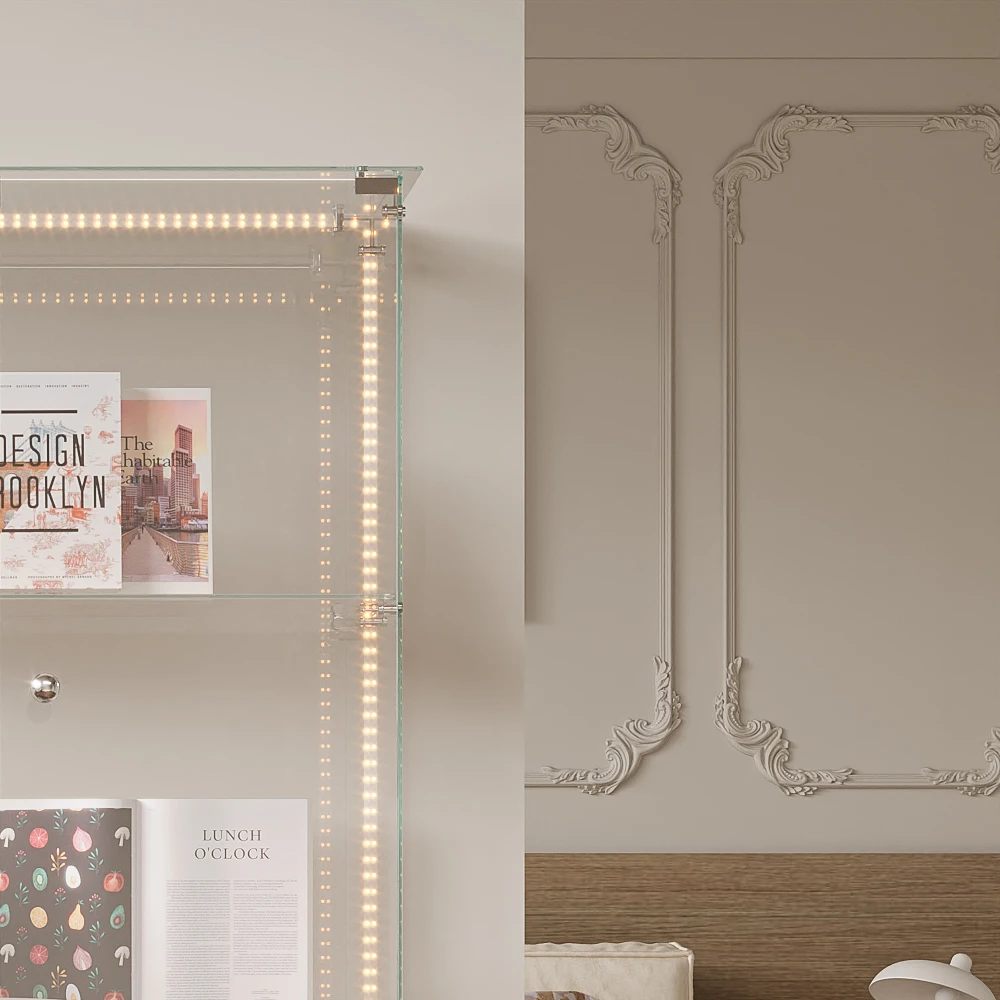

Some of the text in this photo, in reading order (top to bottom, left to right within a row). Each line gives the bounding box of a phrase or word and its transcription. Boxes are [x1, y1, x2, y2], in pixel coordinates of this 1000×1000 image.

[121, 436, 153, 451] The
[121, 452, 193, 468] habitable
[202, 829, 262, 842] LUNCH
[194, 847, 271, 860] O'CLOCK
